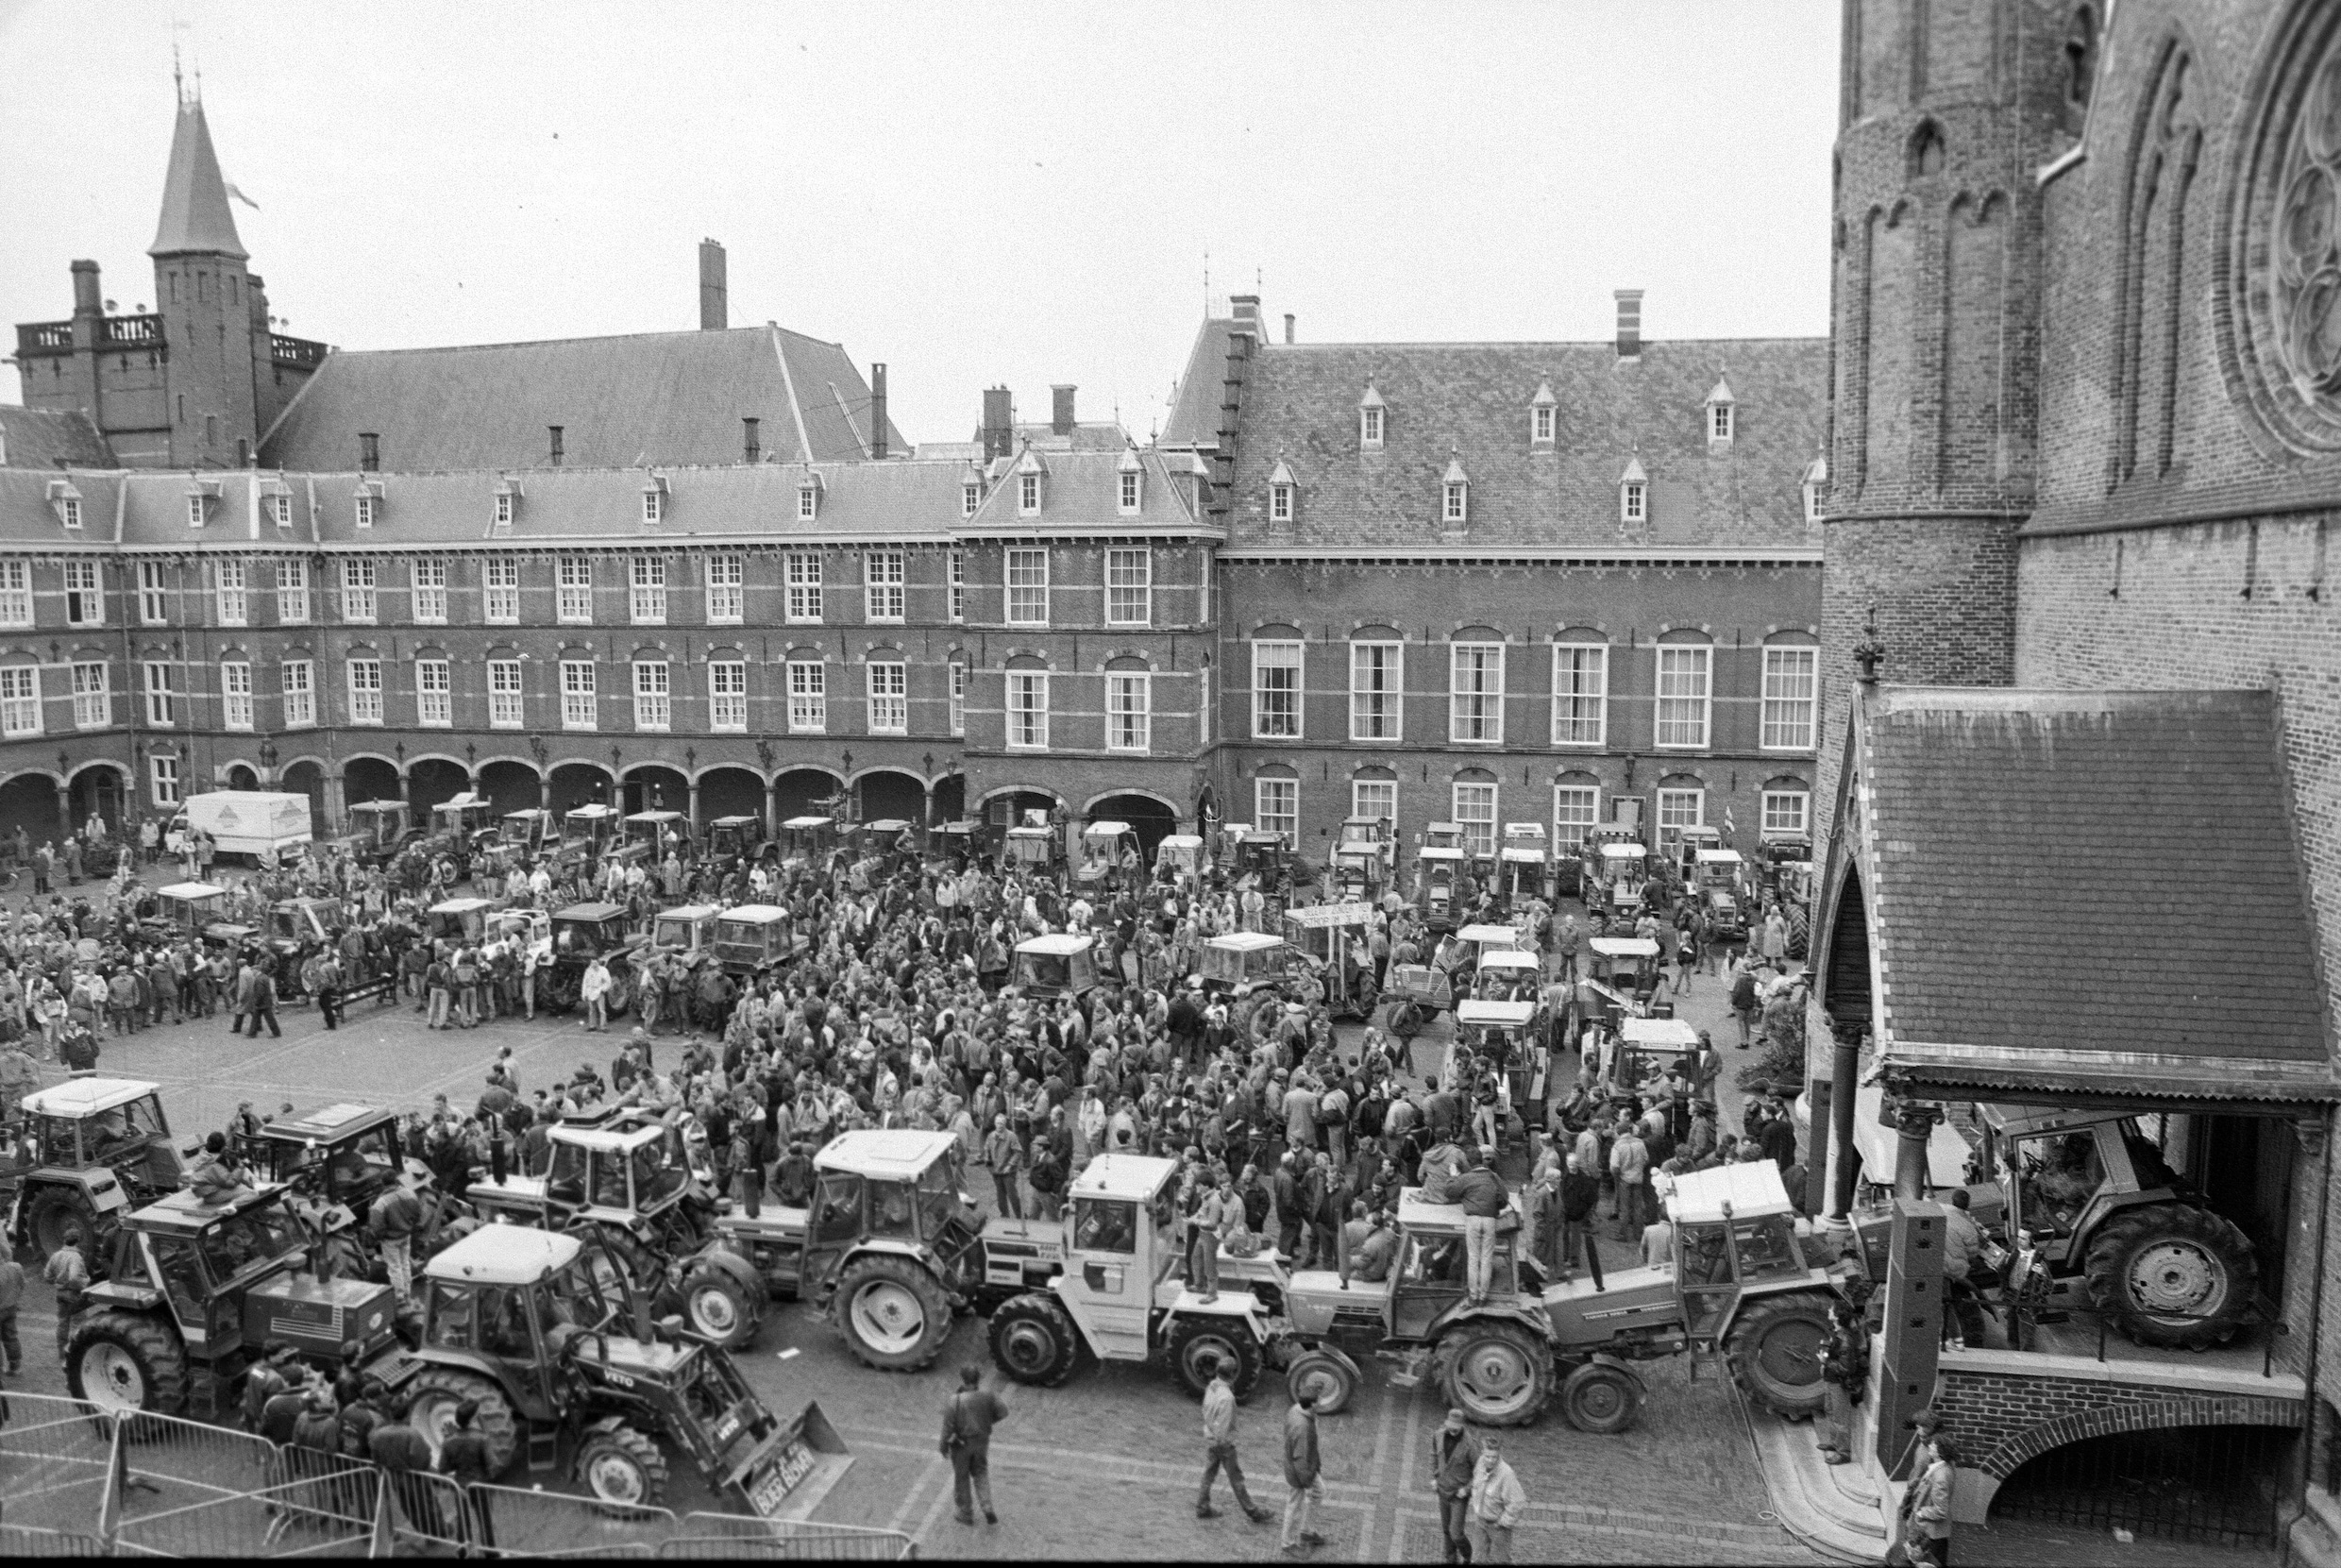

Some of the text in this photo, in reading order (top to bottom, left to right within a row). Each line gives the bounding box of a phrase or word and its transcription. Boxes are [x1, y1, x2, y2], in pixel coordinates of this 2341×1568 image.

[604, 1369, 634, 1388] VETO
[718, 1418, 739, 1441] VETO
[756, 1476, 787, 1515] BOER
